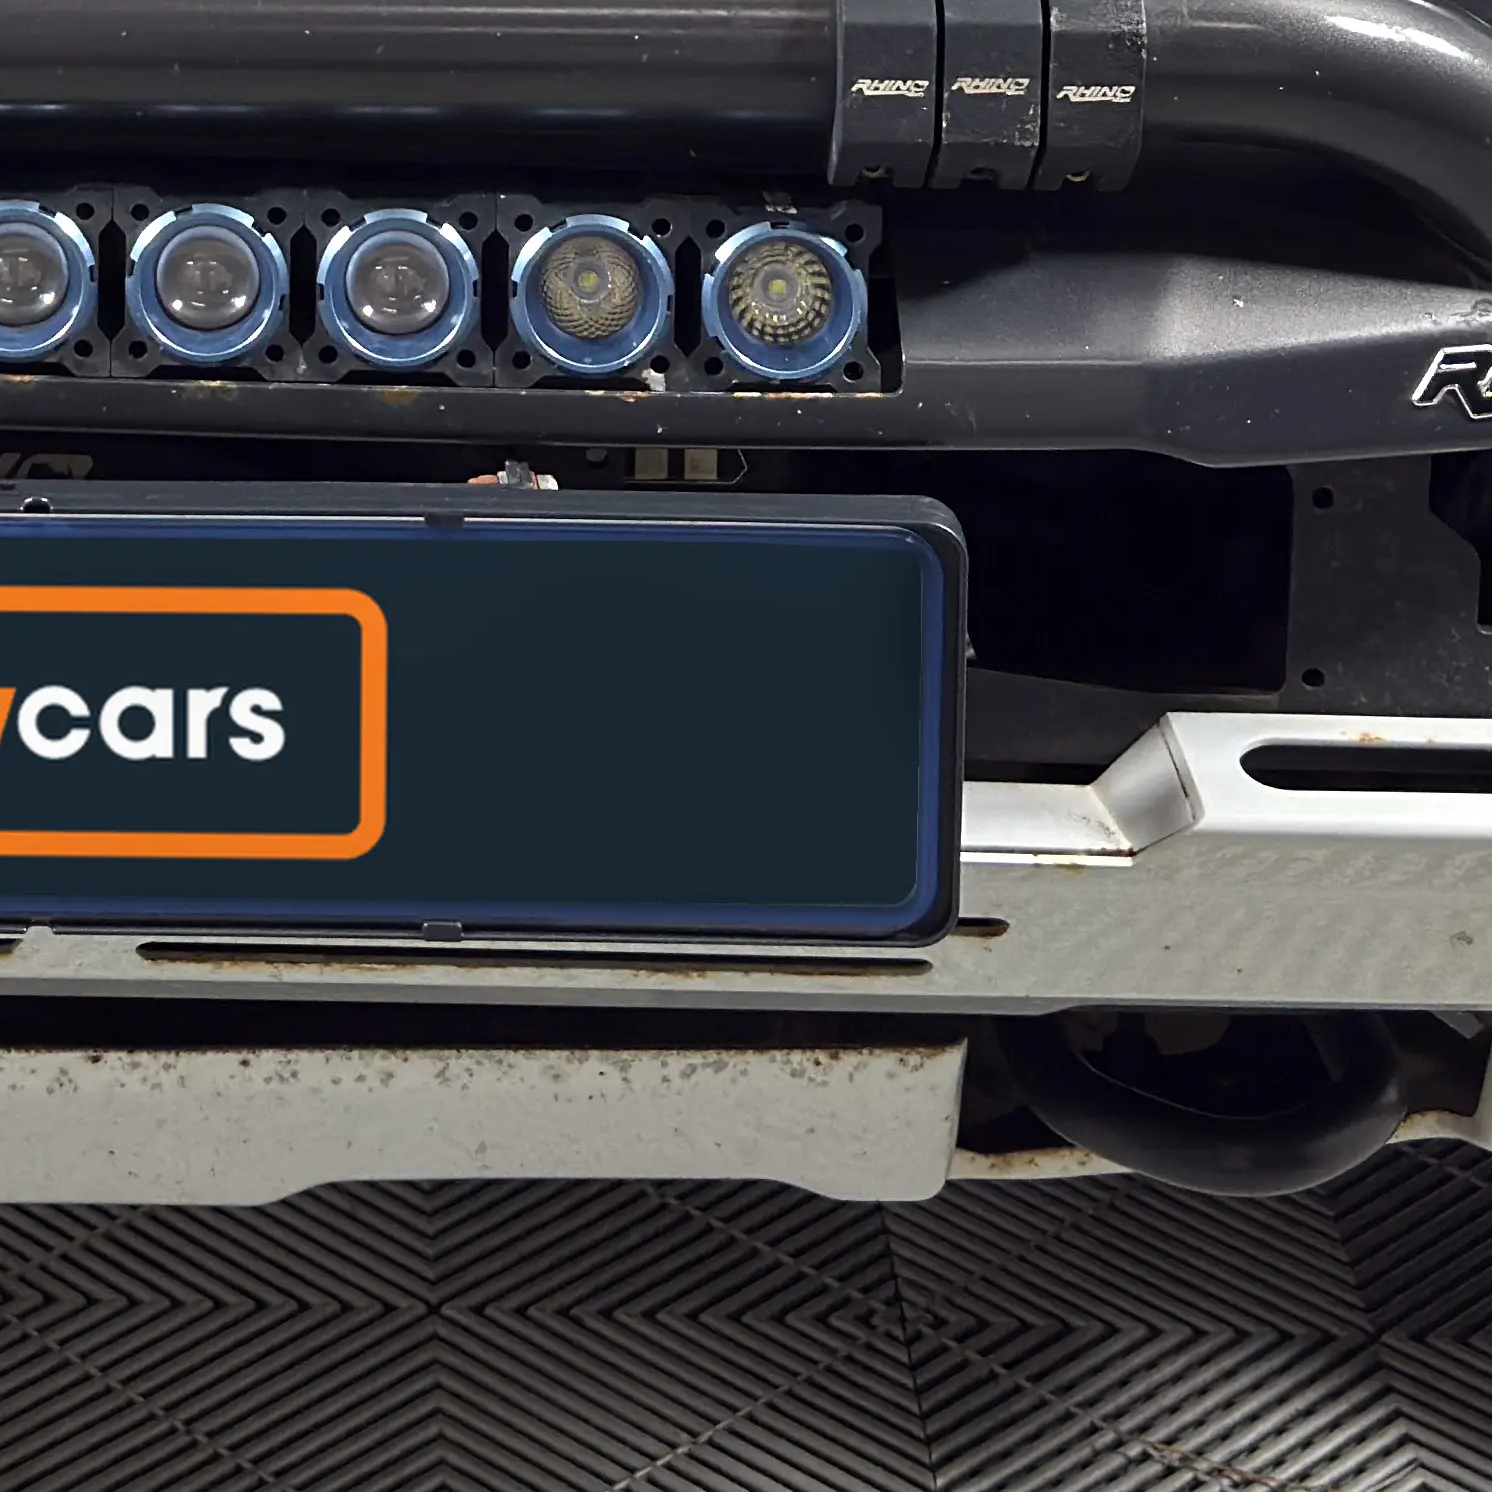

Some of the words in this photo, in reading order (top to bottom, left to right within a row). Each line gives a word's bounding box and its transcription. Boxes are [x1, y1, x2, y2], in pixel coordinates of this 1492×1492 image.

[850, 77, 930, 97] RHINO
[951, 77, 1030, 96] RHINO
[1056, 84, 1137, 104] RHINO
